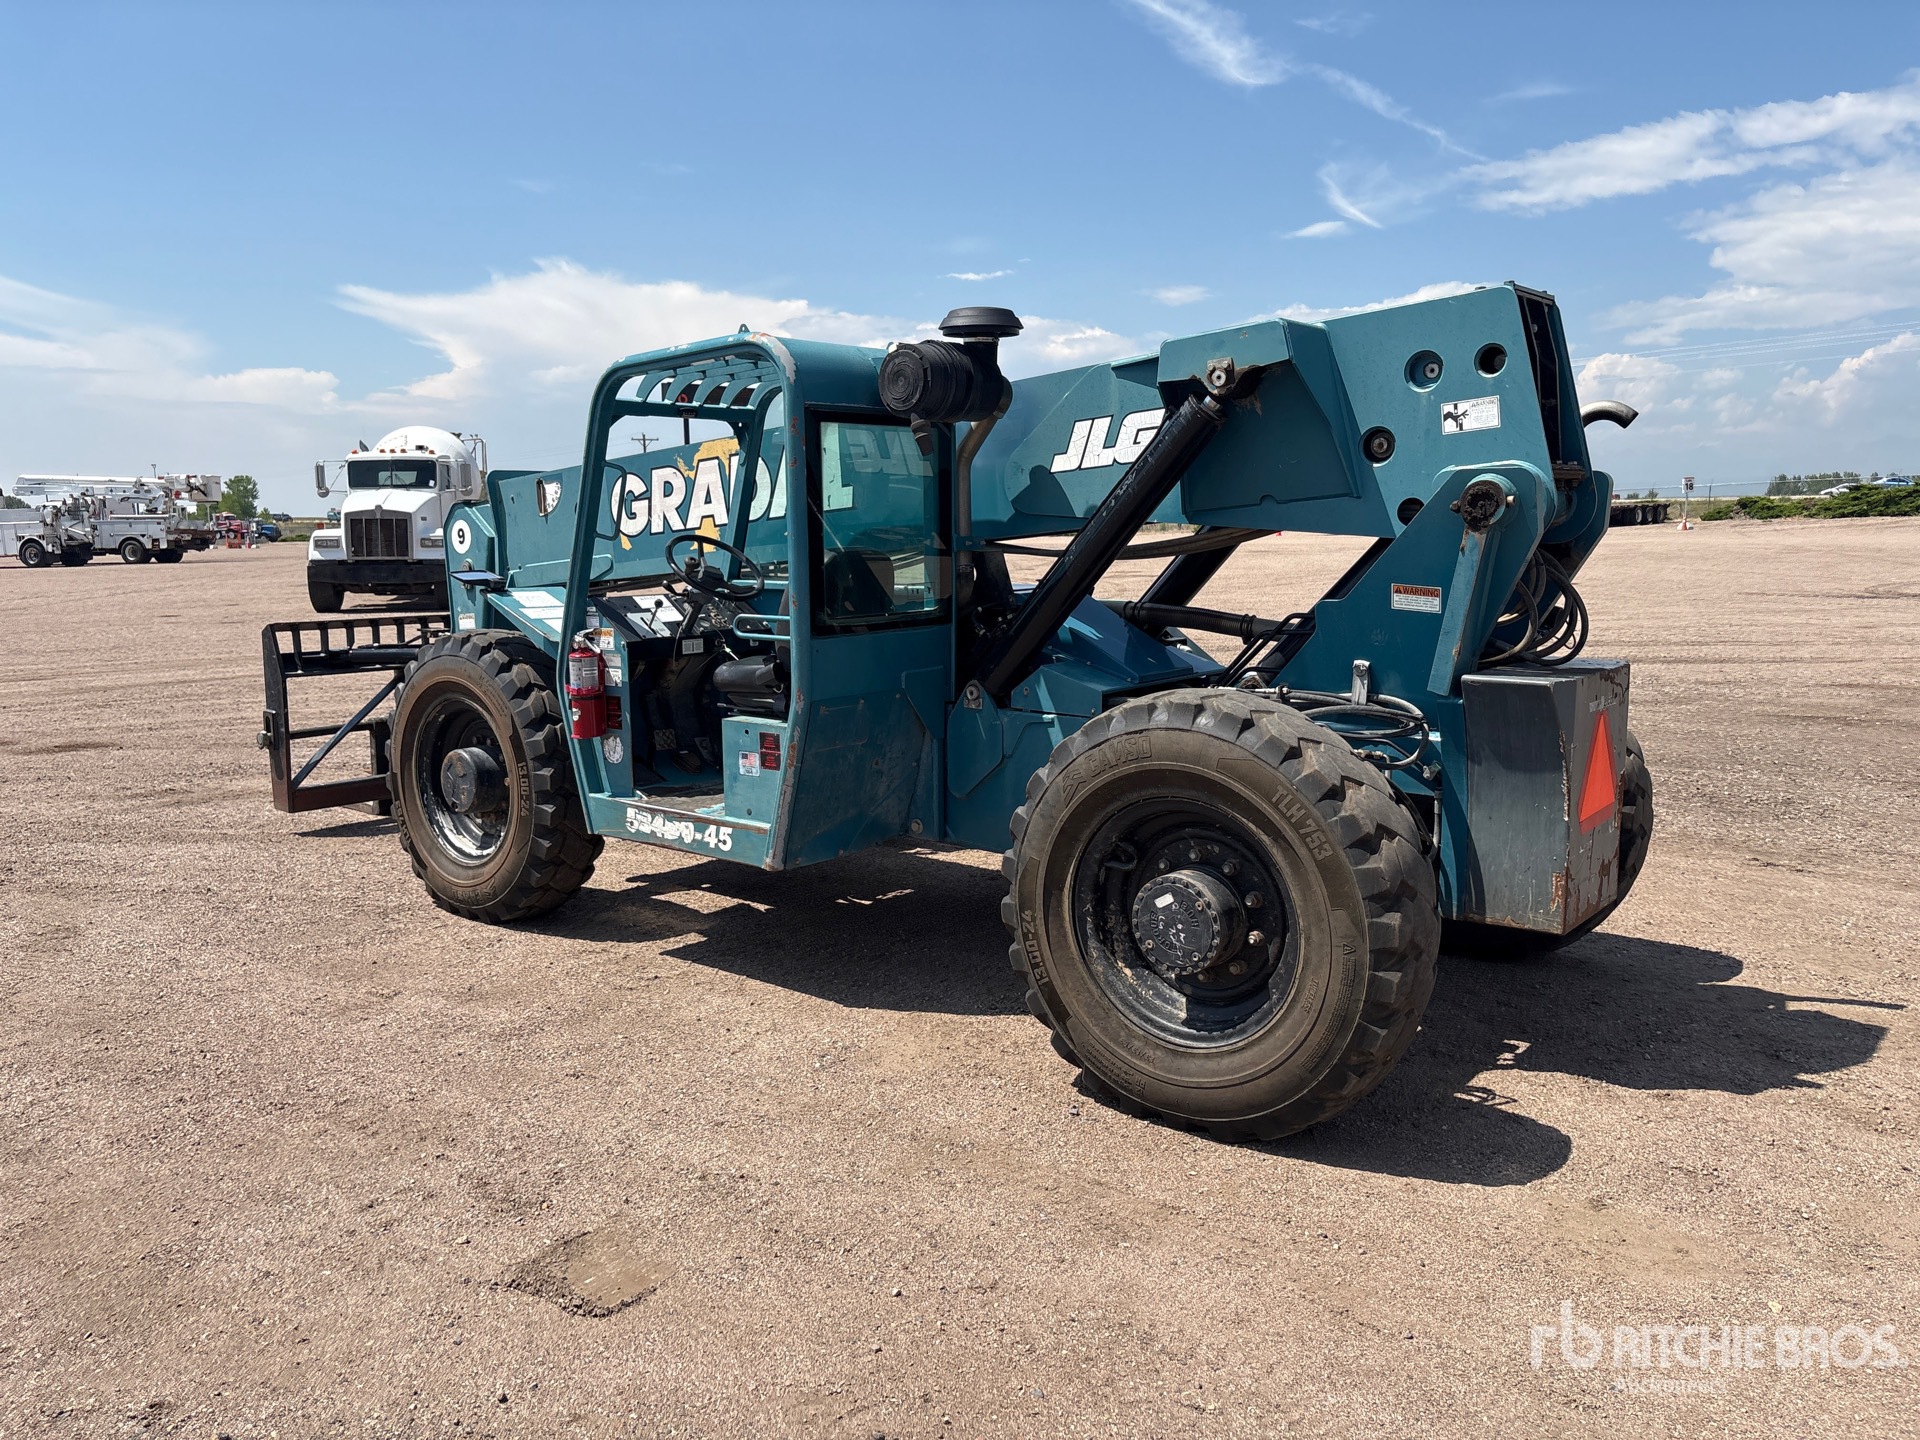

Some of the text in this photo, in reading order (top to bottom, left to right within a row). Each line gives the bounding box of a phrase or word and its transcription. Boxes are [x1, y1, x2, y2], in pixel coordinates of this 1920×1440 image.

[1049, 406, 1166, 474] JLG
[1685, 482, 1694, 491] 18
[457, 527, 466, 545] 9
[1403, 586, 1440, 598] WARNING
[1085, 735, 1152, 778] CAMSO
[516, 761, 530, 818] 13.00-24
[1271, 785, 1334, 861] TLH 753
[1180, 901, 1200, 929] HUB
[1020, 909, 1050, 986] 13.00-24
